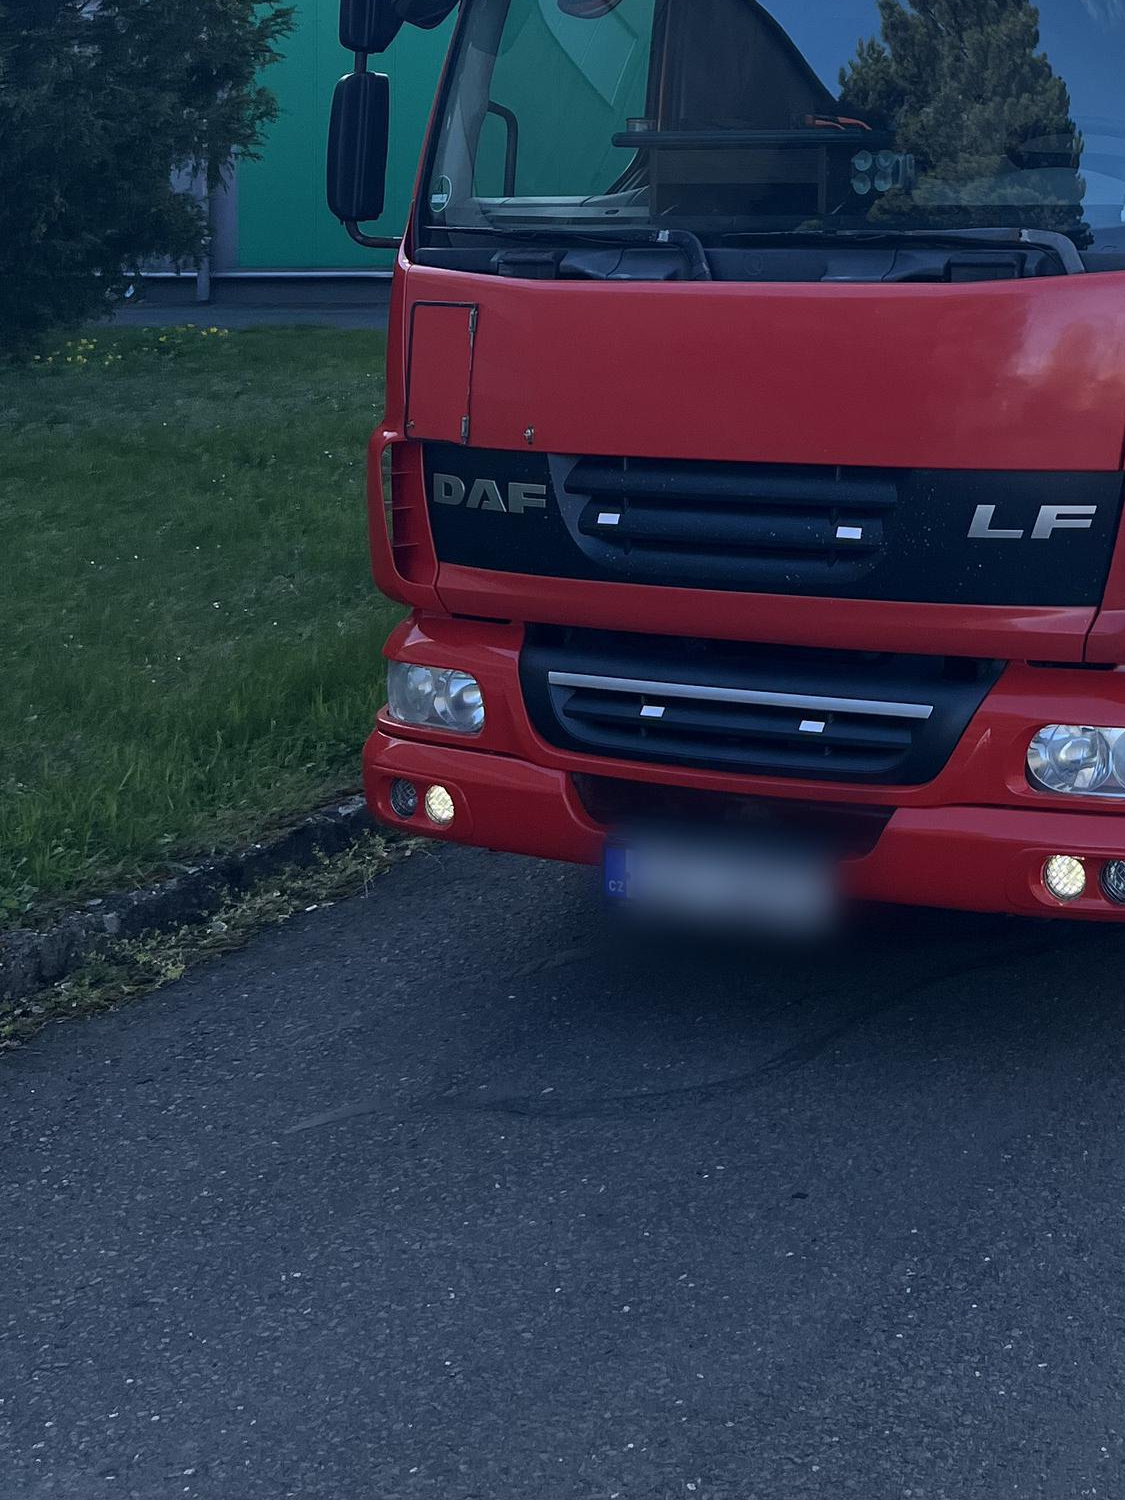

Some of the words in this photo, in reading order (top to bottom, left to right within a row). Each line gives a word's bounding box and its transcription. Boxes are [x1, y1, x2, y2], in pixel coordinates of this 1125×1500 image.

[433, 472, 547, 514] DAF
[967, 504, 1097, 539] LF
[608, 879, 625, 893] CZ
